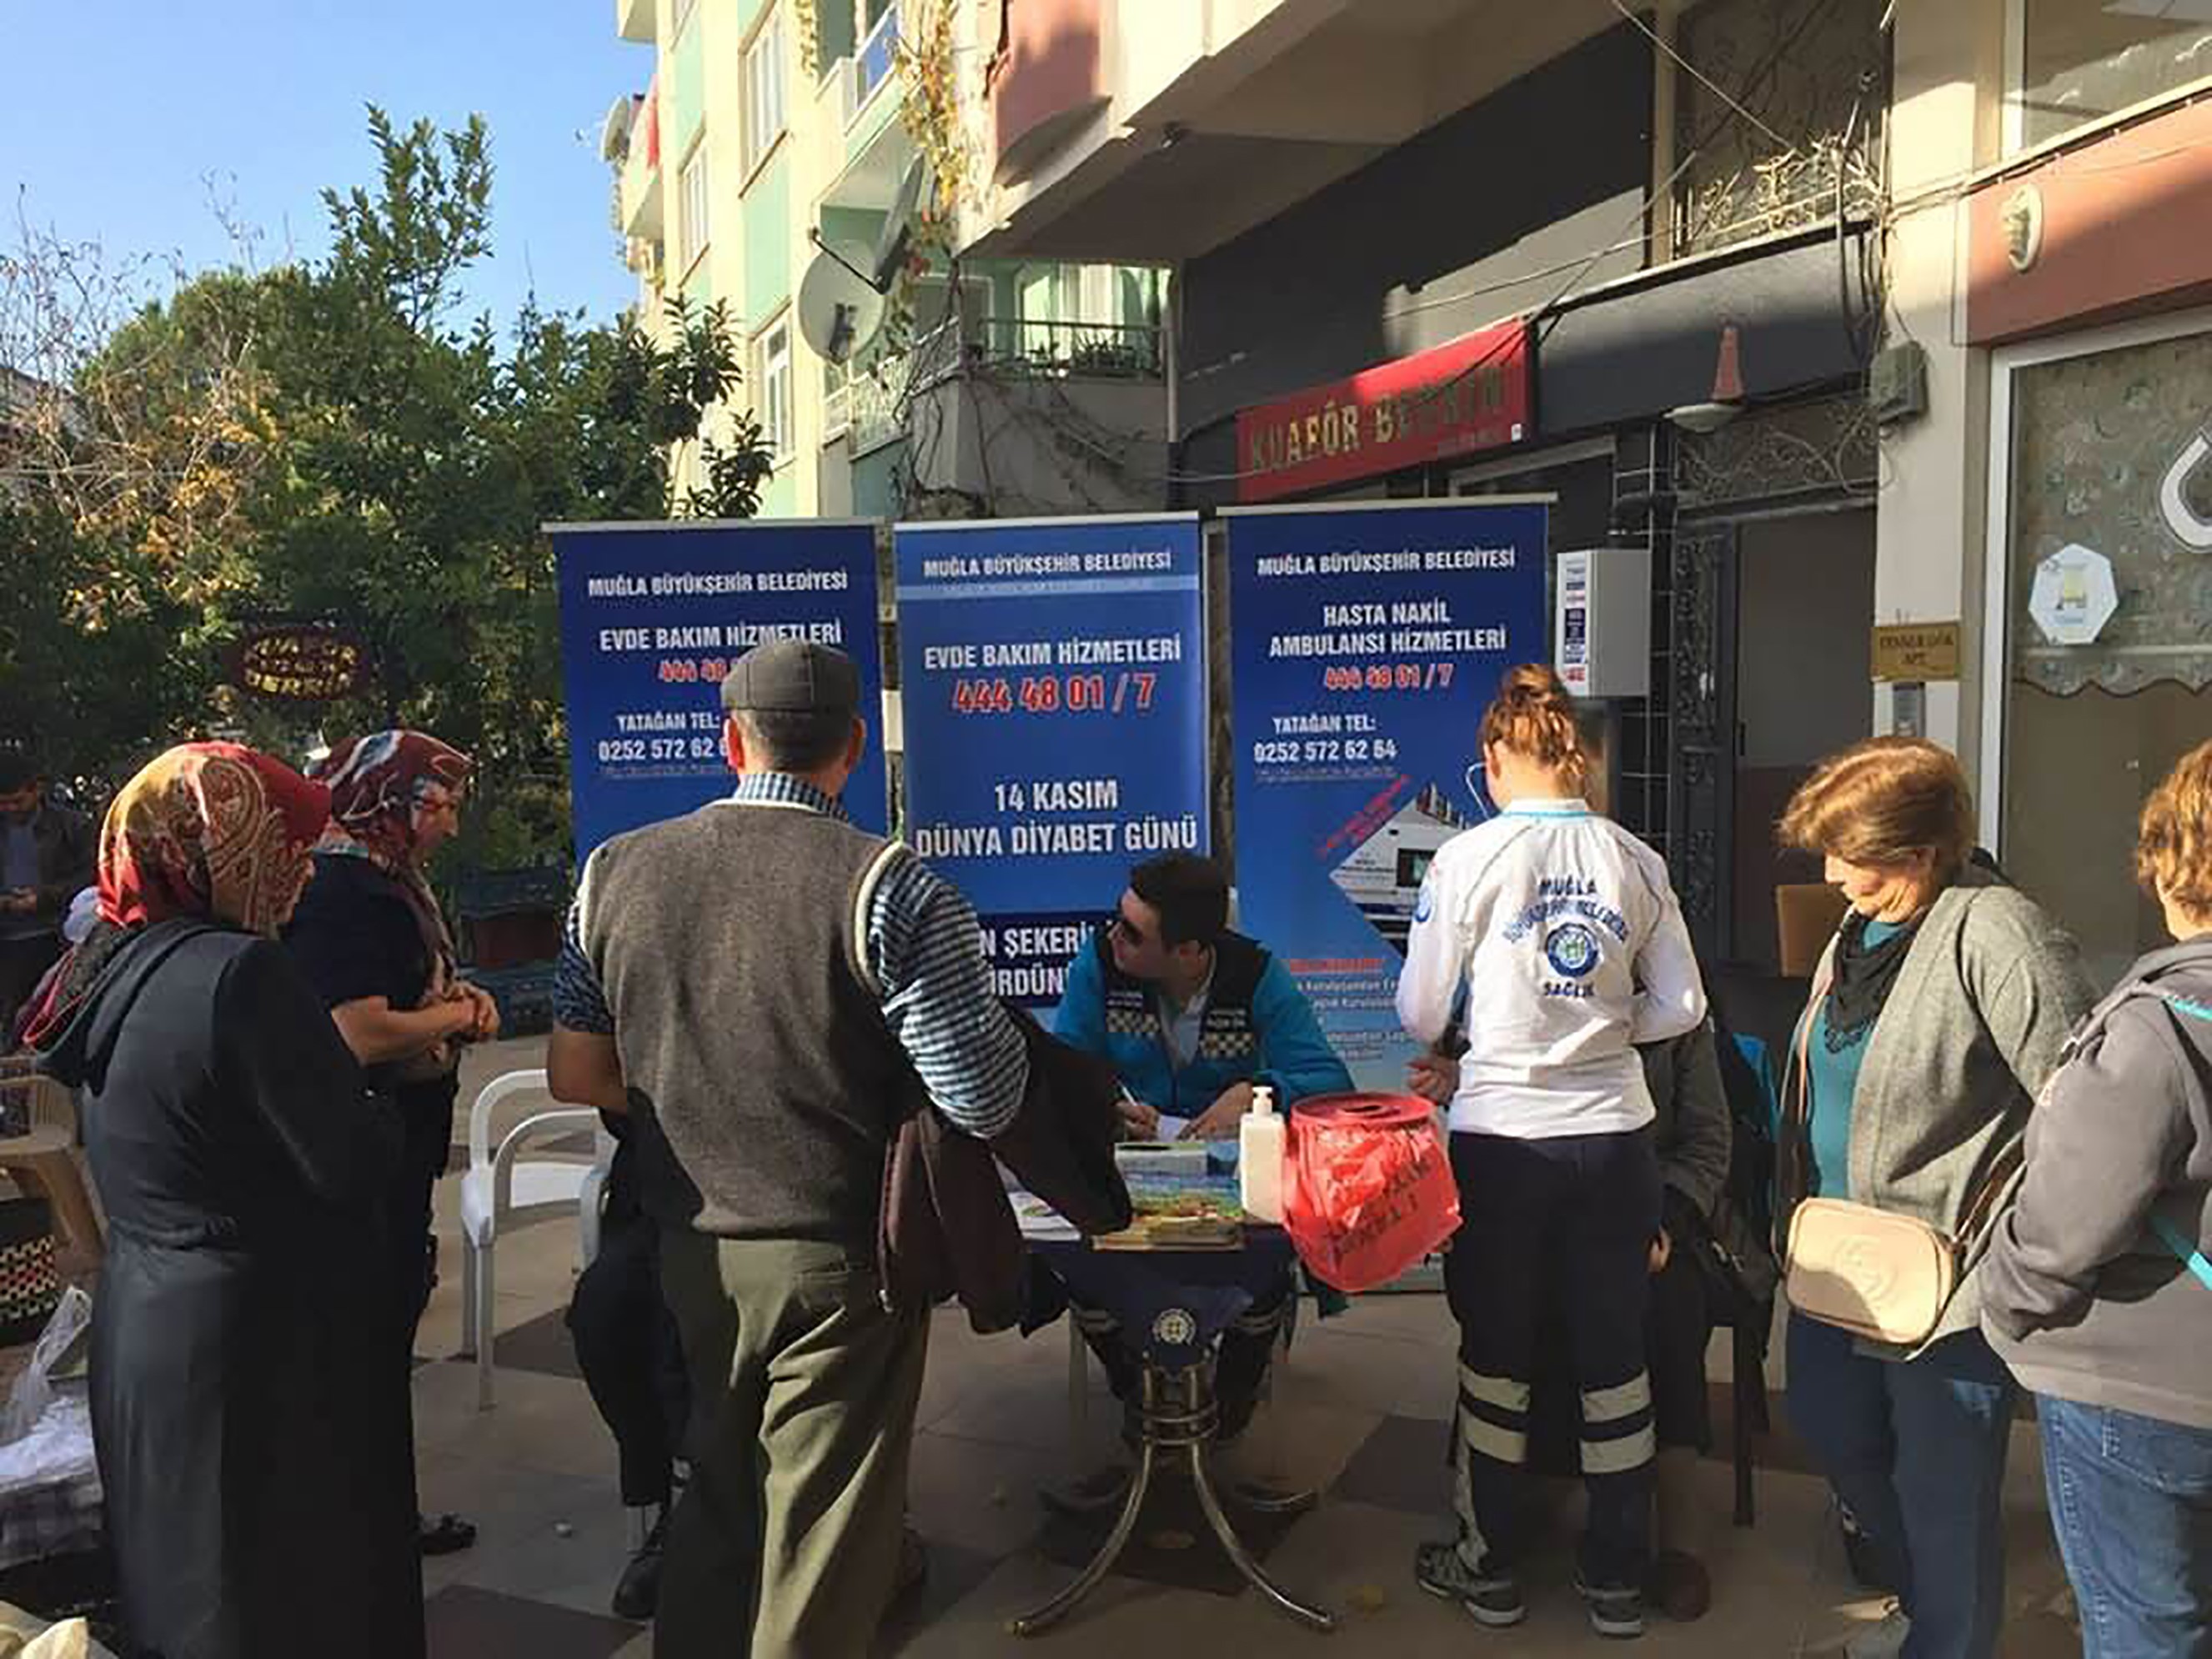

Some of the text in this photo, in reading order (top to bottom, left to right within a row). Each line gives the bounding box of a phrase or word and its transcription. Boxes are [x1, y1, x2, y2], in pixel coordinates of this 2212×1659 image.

[924, 549, 1171, 577] MUĞLA BÜYÜKŞEHİR BELEDİYESİ
[1257, 544, 1516, 575] MUĞLA BÜYÜKŞEHİR BELEDİYESİ
[588, 567, 849, 597] MUĞLA BÜYÜKŞEHİR BELEDİYESİ
[1323, 597, 1452, 628] HASTA NAKİL
[599, 628, 650, 651] EVDE
[655, 625, 721, 649] BAKIM
[924, 633, 1181, 669] EVDE BAKIM HİZMETLERİ
[1269, 624, 1506, 658] AMBULANSI HİZMETLERİ
[952, 672, 1156, 713] 444 48 01 / 7
[615, 710, 720, 732] YATAĞAN TEL:
[1272, 714, 1377, 734] YATAĞAN TEL:
[598, 739, 646, 762] 0252
[651, 739, 685, 759] 572
[691, 738, 715, 759] 62
[1253, 742, 1302, 764] 0252
[1305, 740, 1340, 762] 572
[995, 779, 1118, 813] 14 KASIM
[916, 814, 1198, 859] DÜNYA DİYABET GÜNÜ
